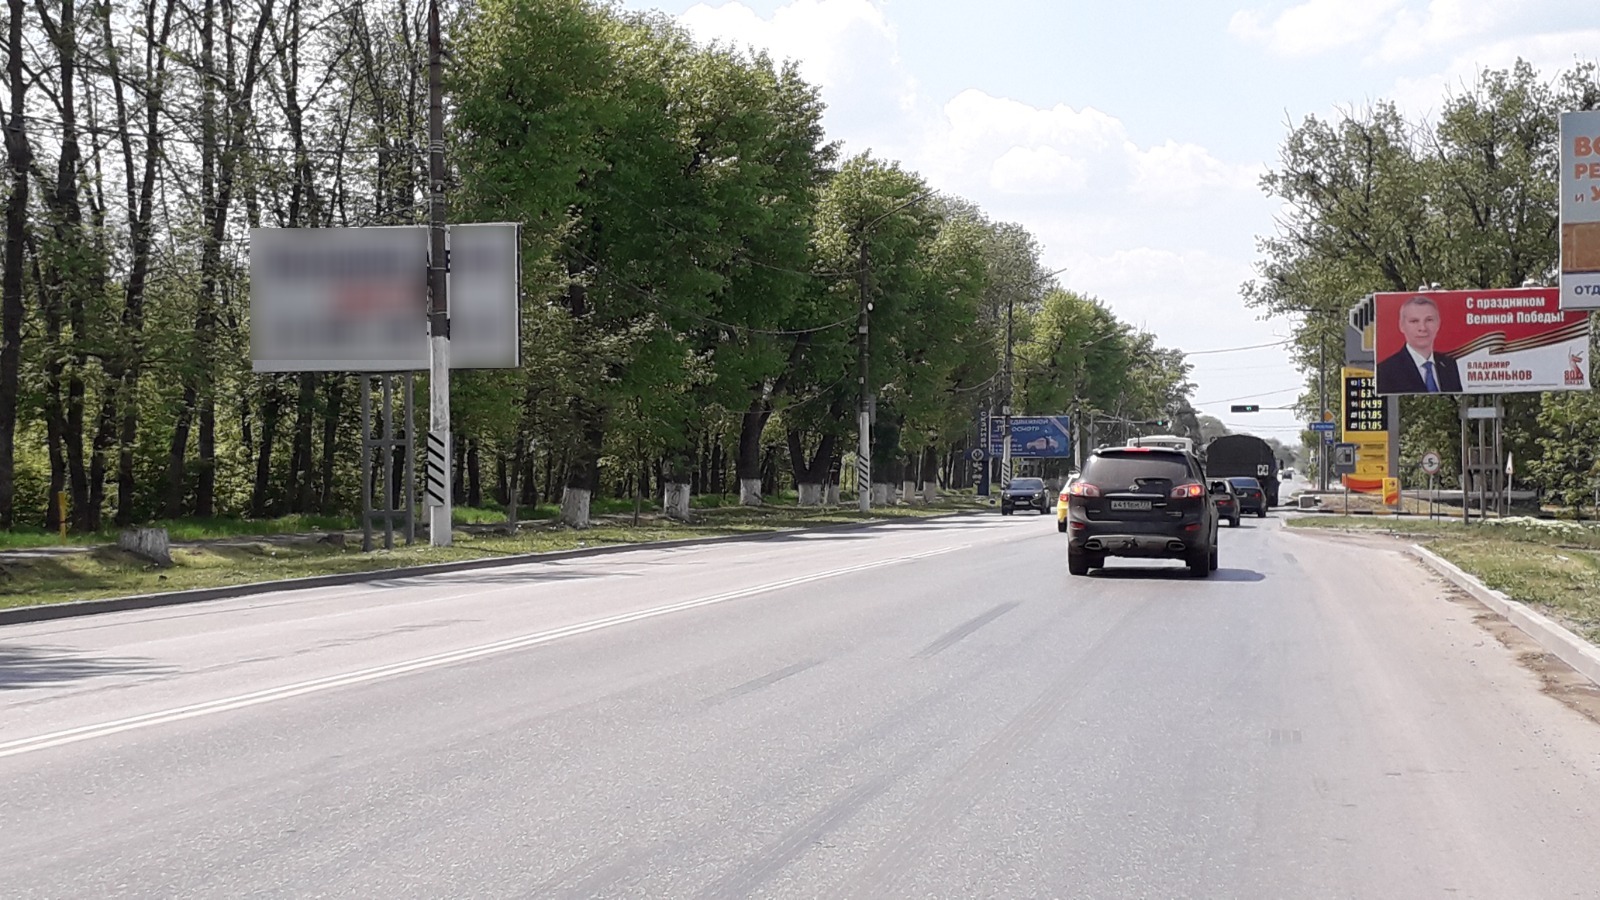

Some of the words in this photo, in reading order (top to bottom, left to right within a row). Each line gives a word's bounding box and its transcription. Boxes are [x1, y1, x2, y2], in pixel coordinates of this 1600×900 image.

[1466, 297, 1474, 309] С
[1477, 297, 1545, 310] праздником
[1466, 312, 1514, 325] Великой
[1516, 311, 1565, 323] Победы!
[1467, 361, 1510, 369] ВЛАДИМИР
[1467, 370, 1533, 381] МАХАНЬКОВ
[1428, 457, 1434, 468] 5
